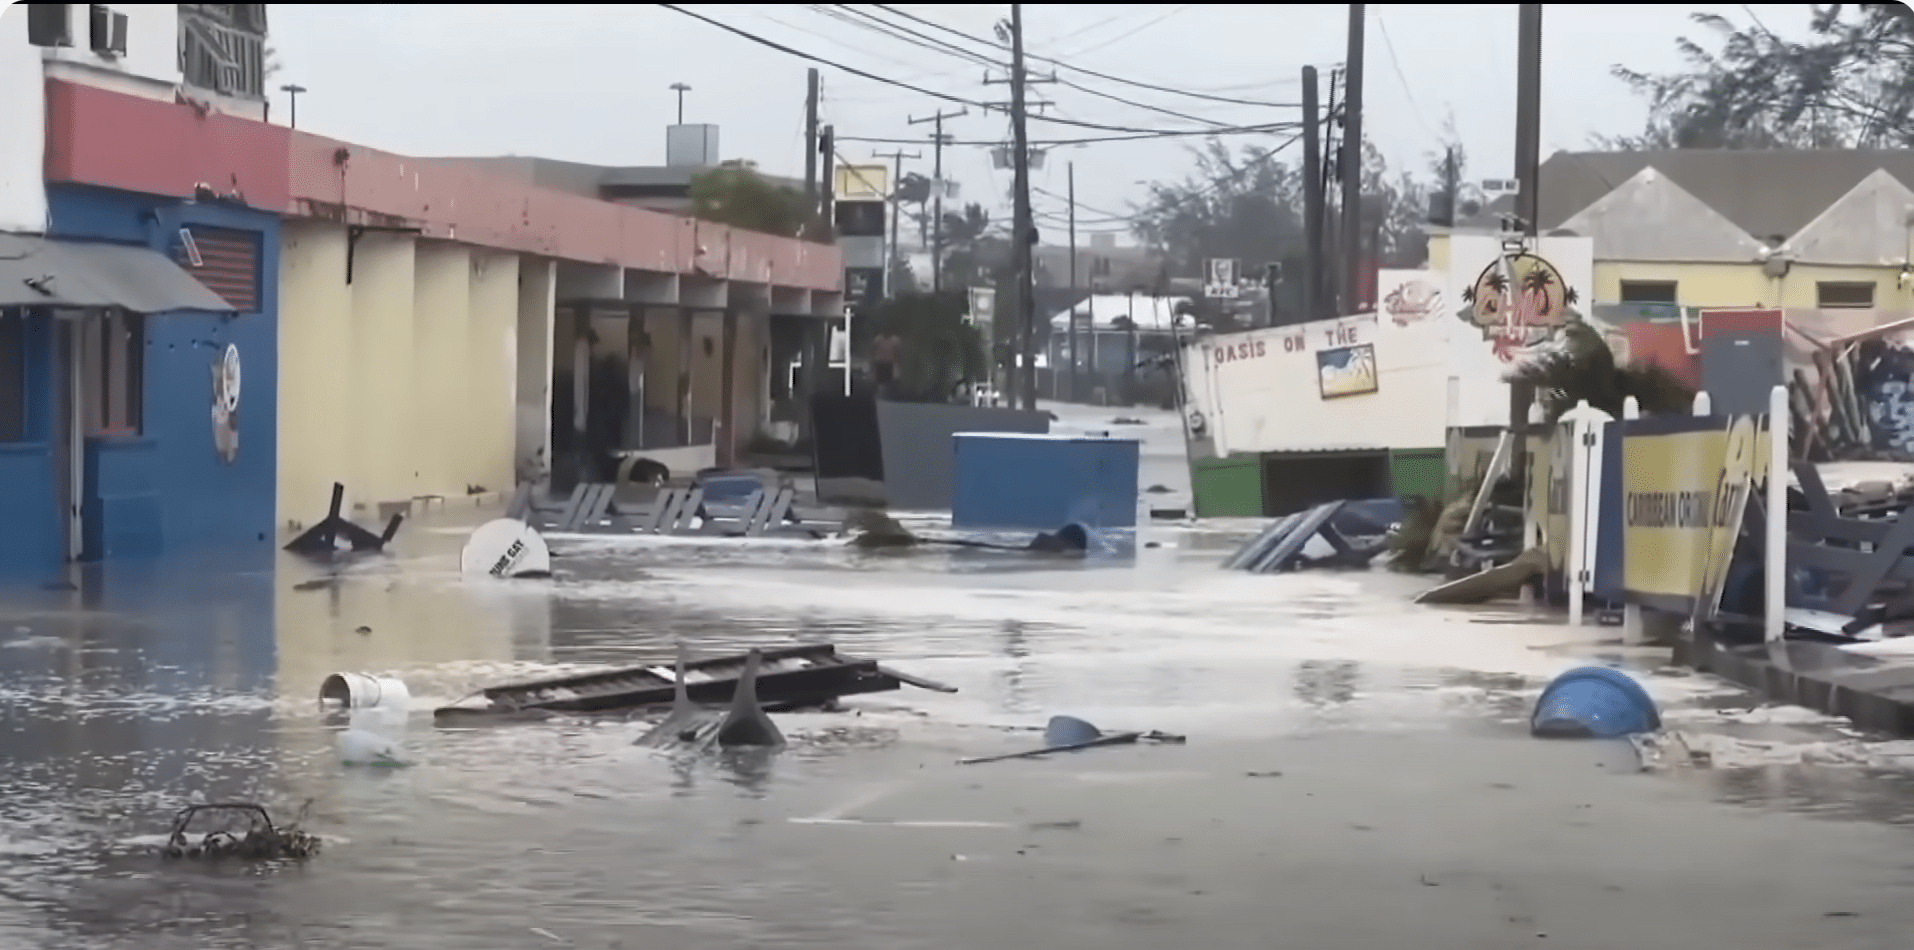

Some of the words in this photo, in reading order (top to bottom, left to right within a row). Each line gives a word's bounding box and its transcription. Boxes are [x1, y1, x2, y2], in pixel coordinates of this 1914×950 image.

[1215, 340, 1267, 364] OASIS
[1284, 335, 1306, 353] ON
[1325, 327, 1358, 347] THE
